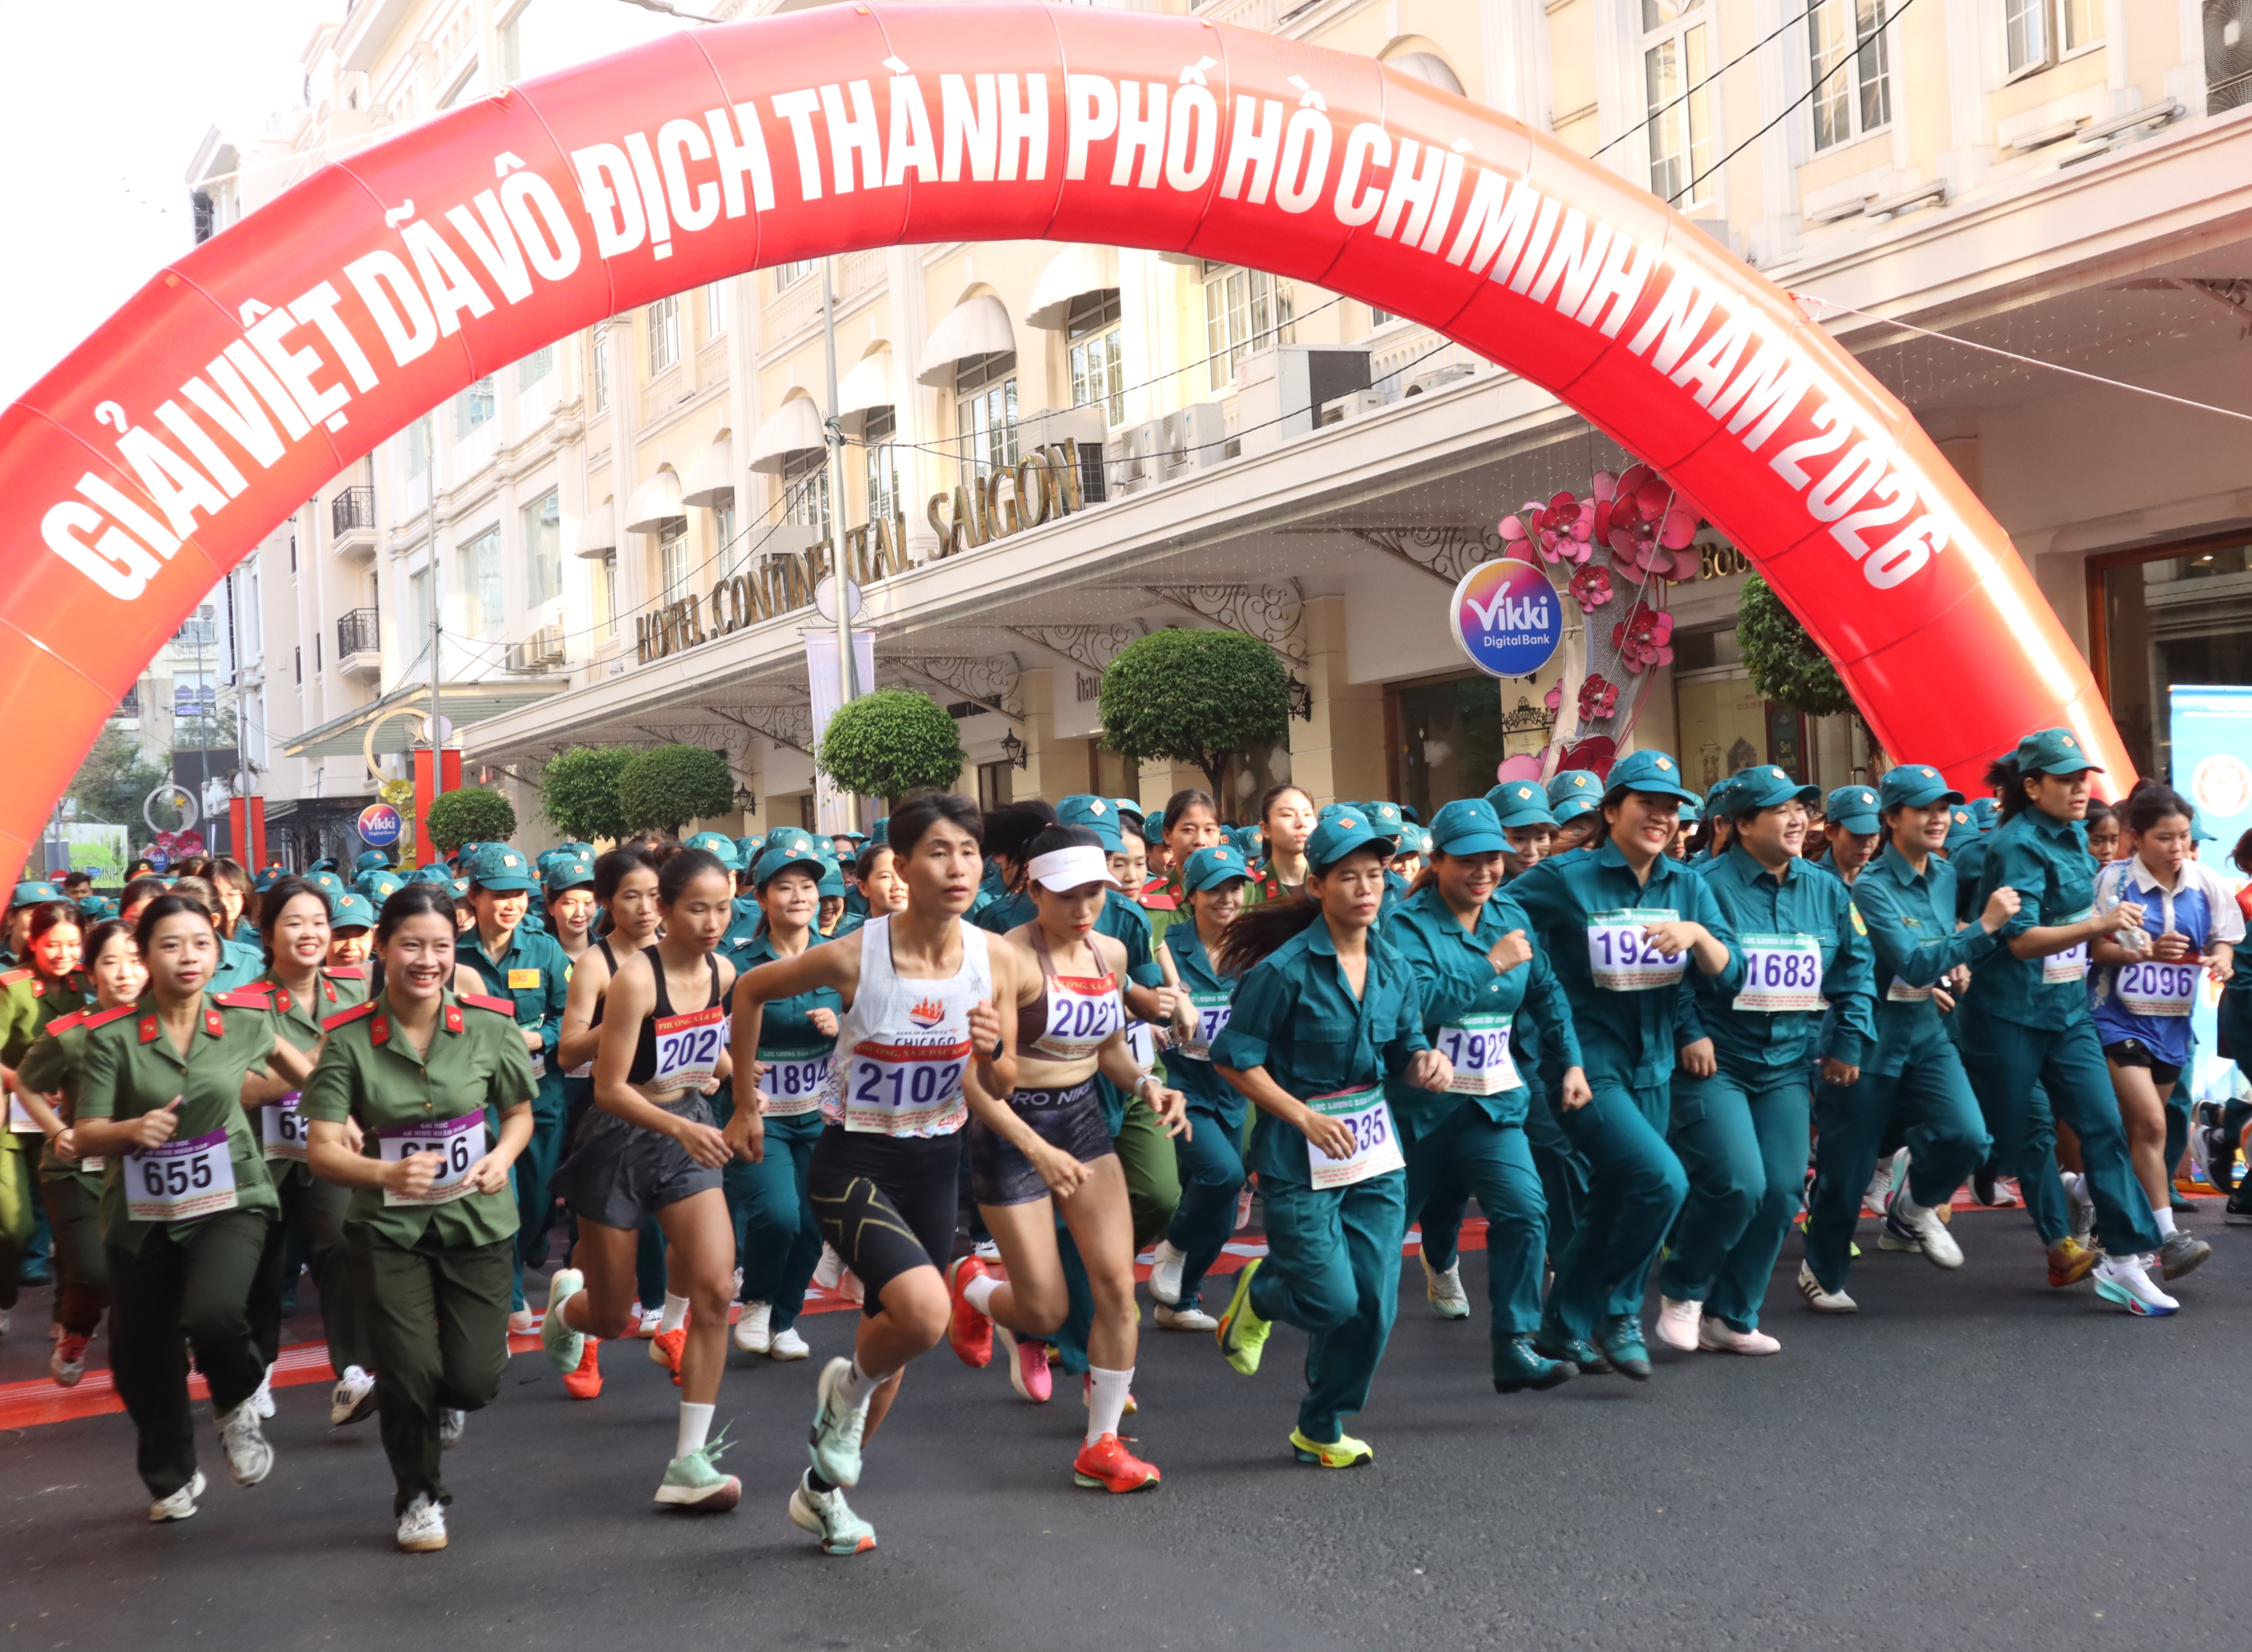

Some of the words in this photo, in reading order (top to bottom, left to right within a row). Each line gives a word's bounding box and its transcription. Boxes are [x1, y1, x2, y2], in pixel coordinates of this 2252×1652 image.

[41, 399, 249, 600] GIẢI
[180, 281, 379, 468] VIỆT
[343, 198, 495, 367] DÃ
[473, 151, 581, 304] VÔ
[570, 101, 775, 260] ĐỊCH
[771, 55, 1049, 202] THÀNH
[1065, 55, 1218, 192] PHỐ
[1219, 75, 1332, 213] HỒ
[1334, 123, 1475, 254] CHÍ
[1445, 167, 1663, 339] MINH
[1769, 399, 1950, 590] 2026
[637, 594, 705, 666] HOTEL
[927, 438, 1081, 562] SAIGON
[1467, 581, 1549, 631] Vikki
[1484, 635, 1520, 649] Digital
[1522, 634, 1550, 645] Bank
[362, 812, 396, 830] Vikki
[1597, 931, 1679, 965] 192
[1749, 953, 1815, 988] 1683
[2123, 965, 2193, 997] 2096
[1050, 997, 1118, 1037] 2021
[894, 1037, 956, 1046] CHICAGO
[1446, 1031, 1507, 1069] 1922
[765, 1057, 829, 1094] 1894
[856, 1062, 961, 1106] 2102
[143, 1153, 212, 1196] 655
